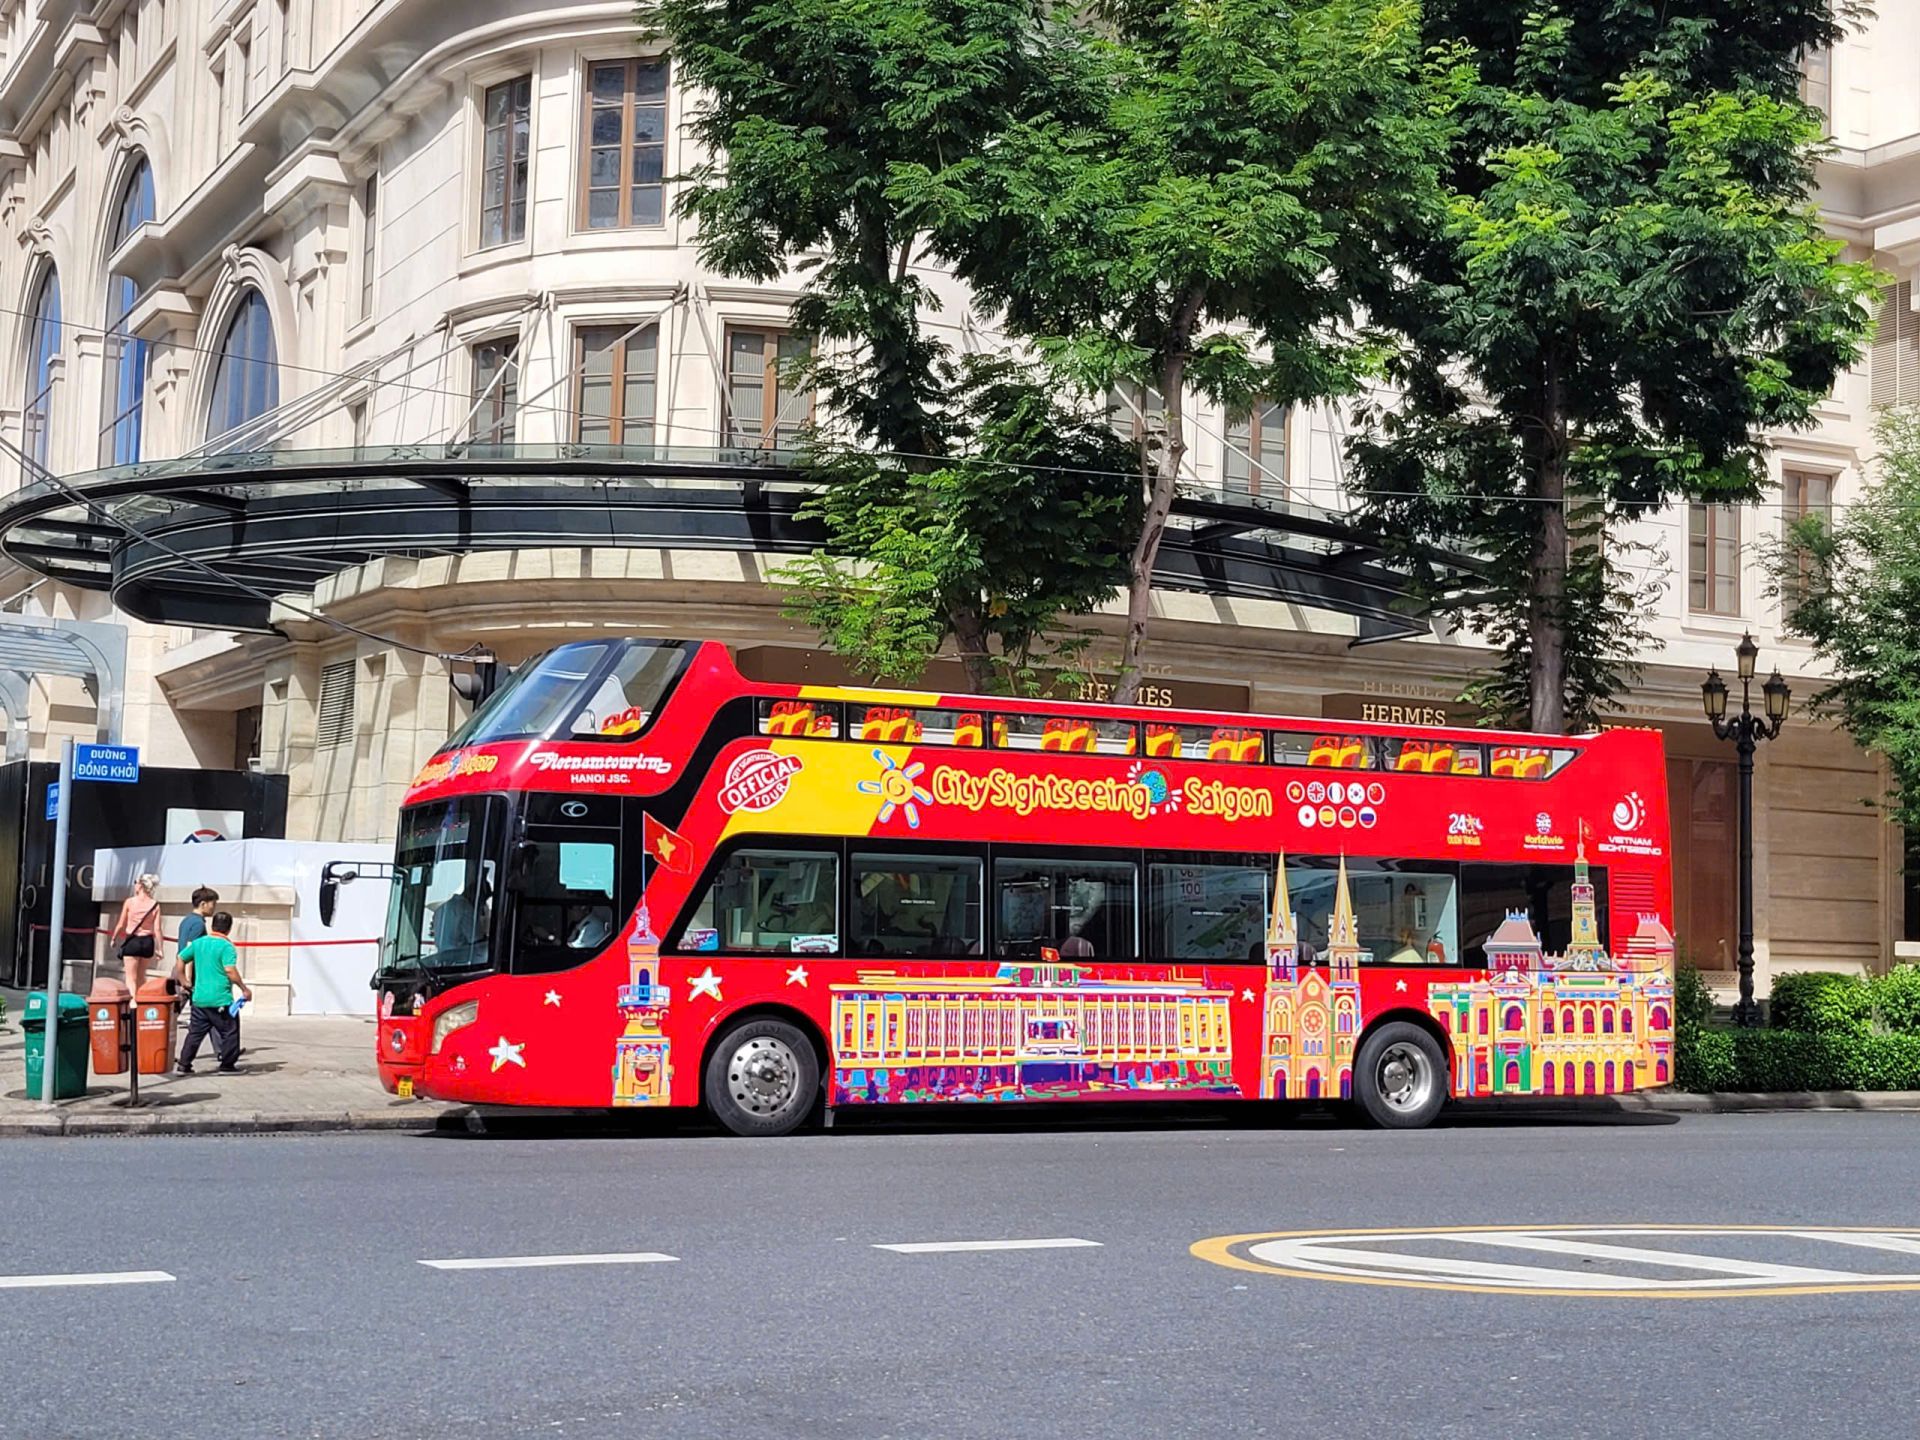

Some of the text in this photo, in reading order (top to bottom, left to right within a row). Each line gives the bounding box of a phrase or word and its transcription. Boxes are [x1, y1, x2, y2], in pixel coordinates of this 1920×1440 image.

[1079, 683, 1172, 707] HEÈS
[1362, 703, 1446, 726] HERMÈS
[78, 760, 136, 778] ĐỒNG KHỞI
[570, 773, 605, 784] HANOI
[727, 758, 801, 806] OFFICIAL
[754, 782, 787, 807] TOUR
[1184, 776, 1273, 822] Saigon
[1607, 836, 1653, 846] VIETNAM
